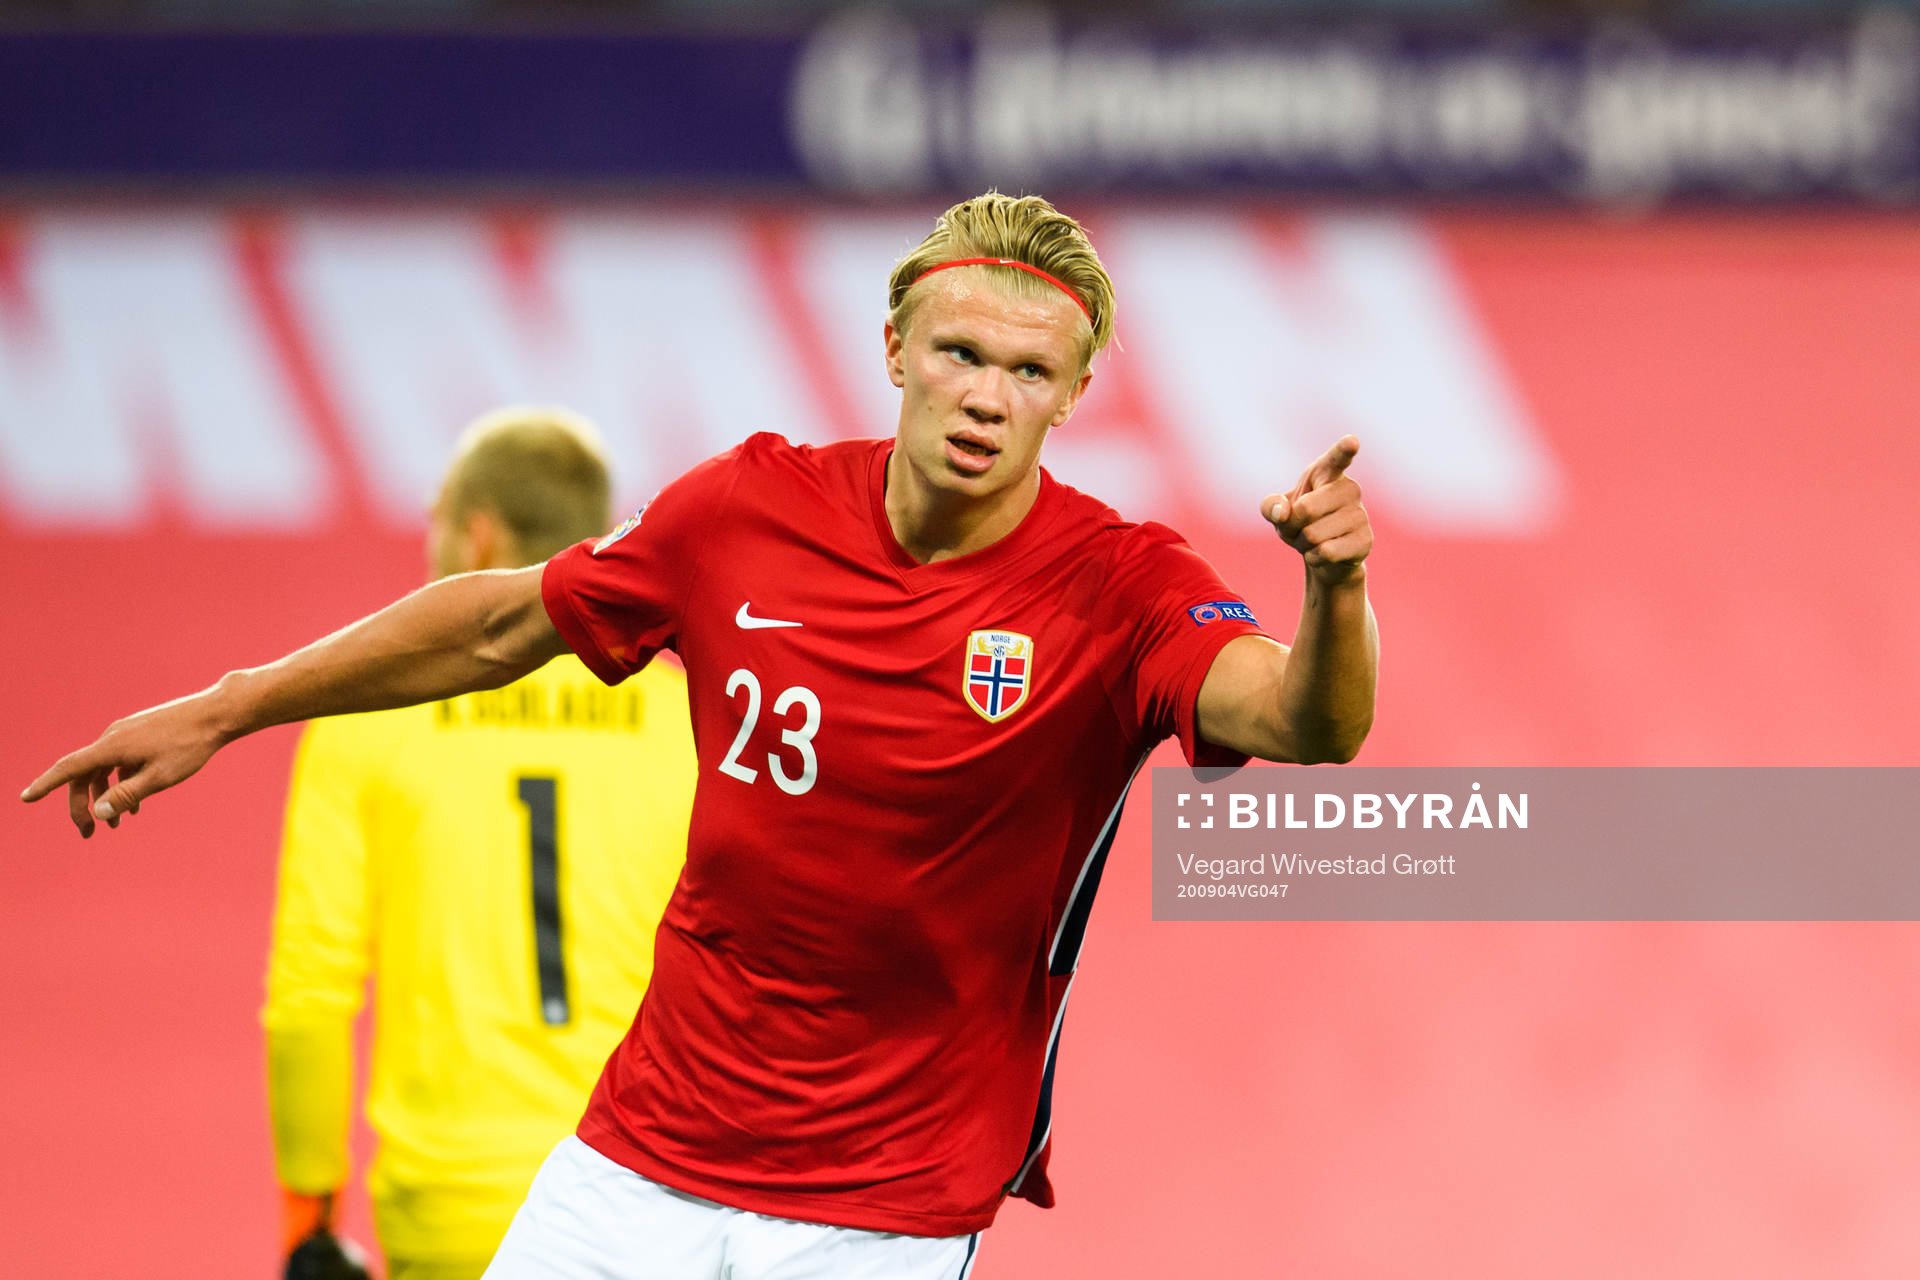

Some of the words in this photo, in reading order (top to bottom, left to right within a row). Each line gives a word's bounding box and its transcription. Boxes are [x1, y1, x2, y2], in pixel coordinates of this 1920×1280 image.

[990, 634, 1011, 644] NORGE
[1222, 607, 1256, 619] RES
[718, 668, 821, 796] 23
[518, 777, 570, 1024] 1
